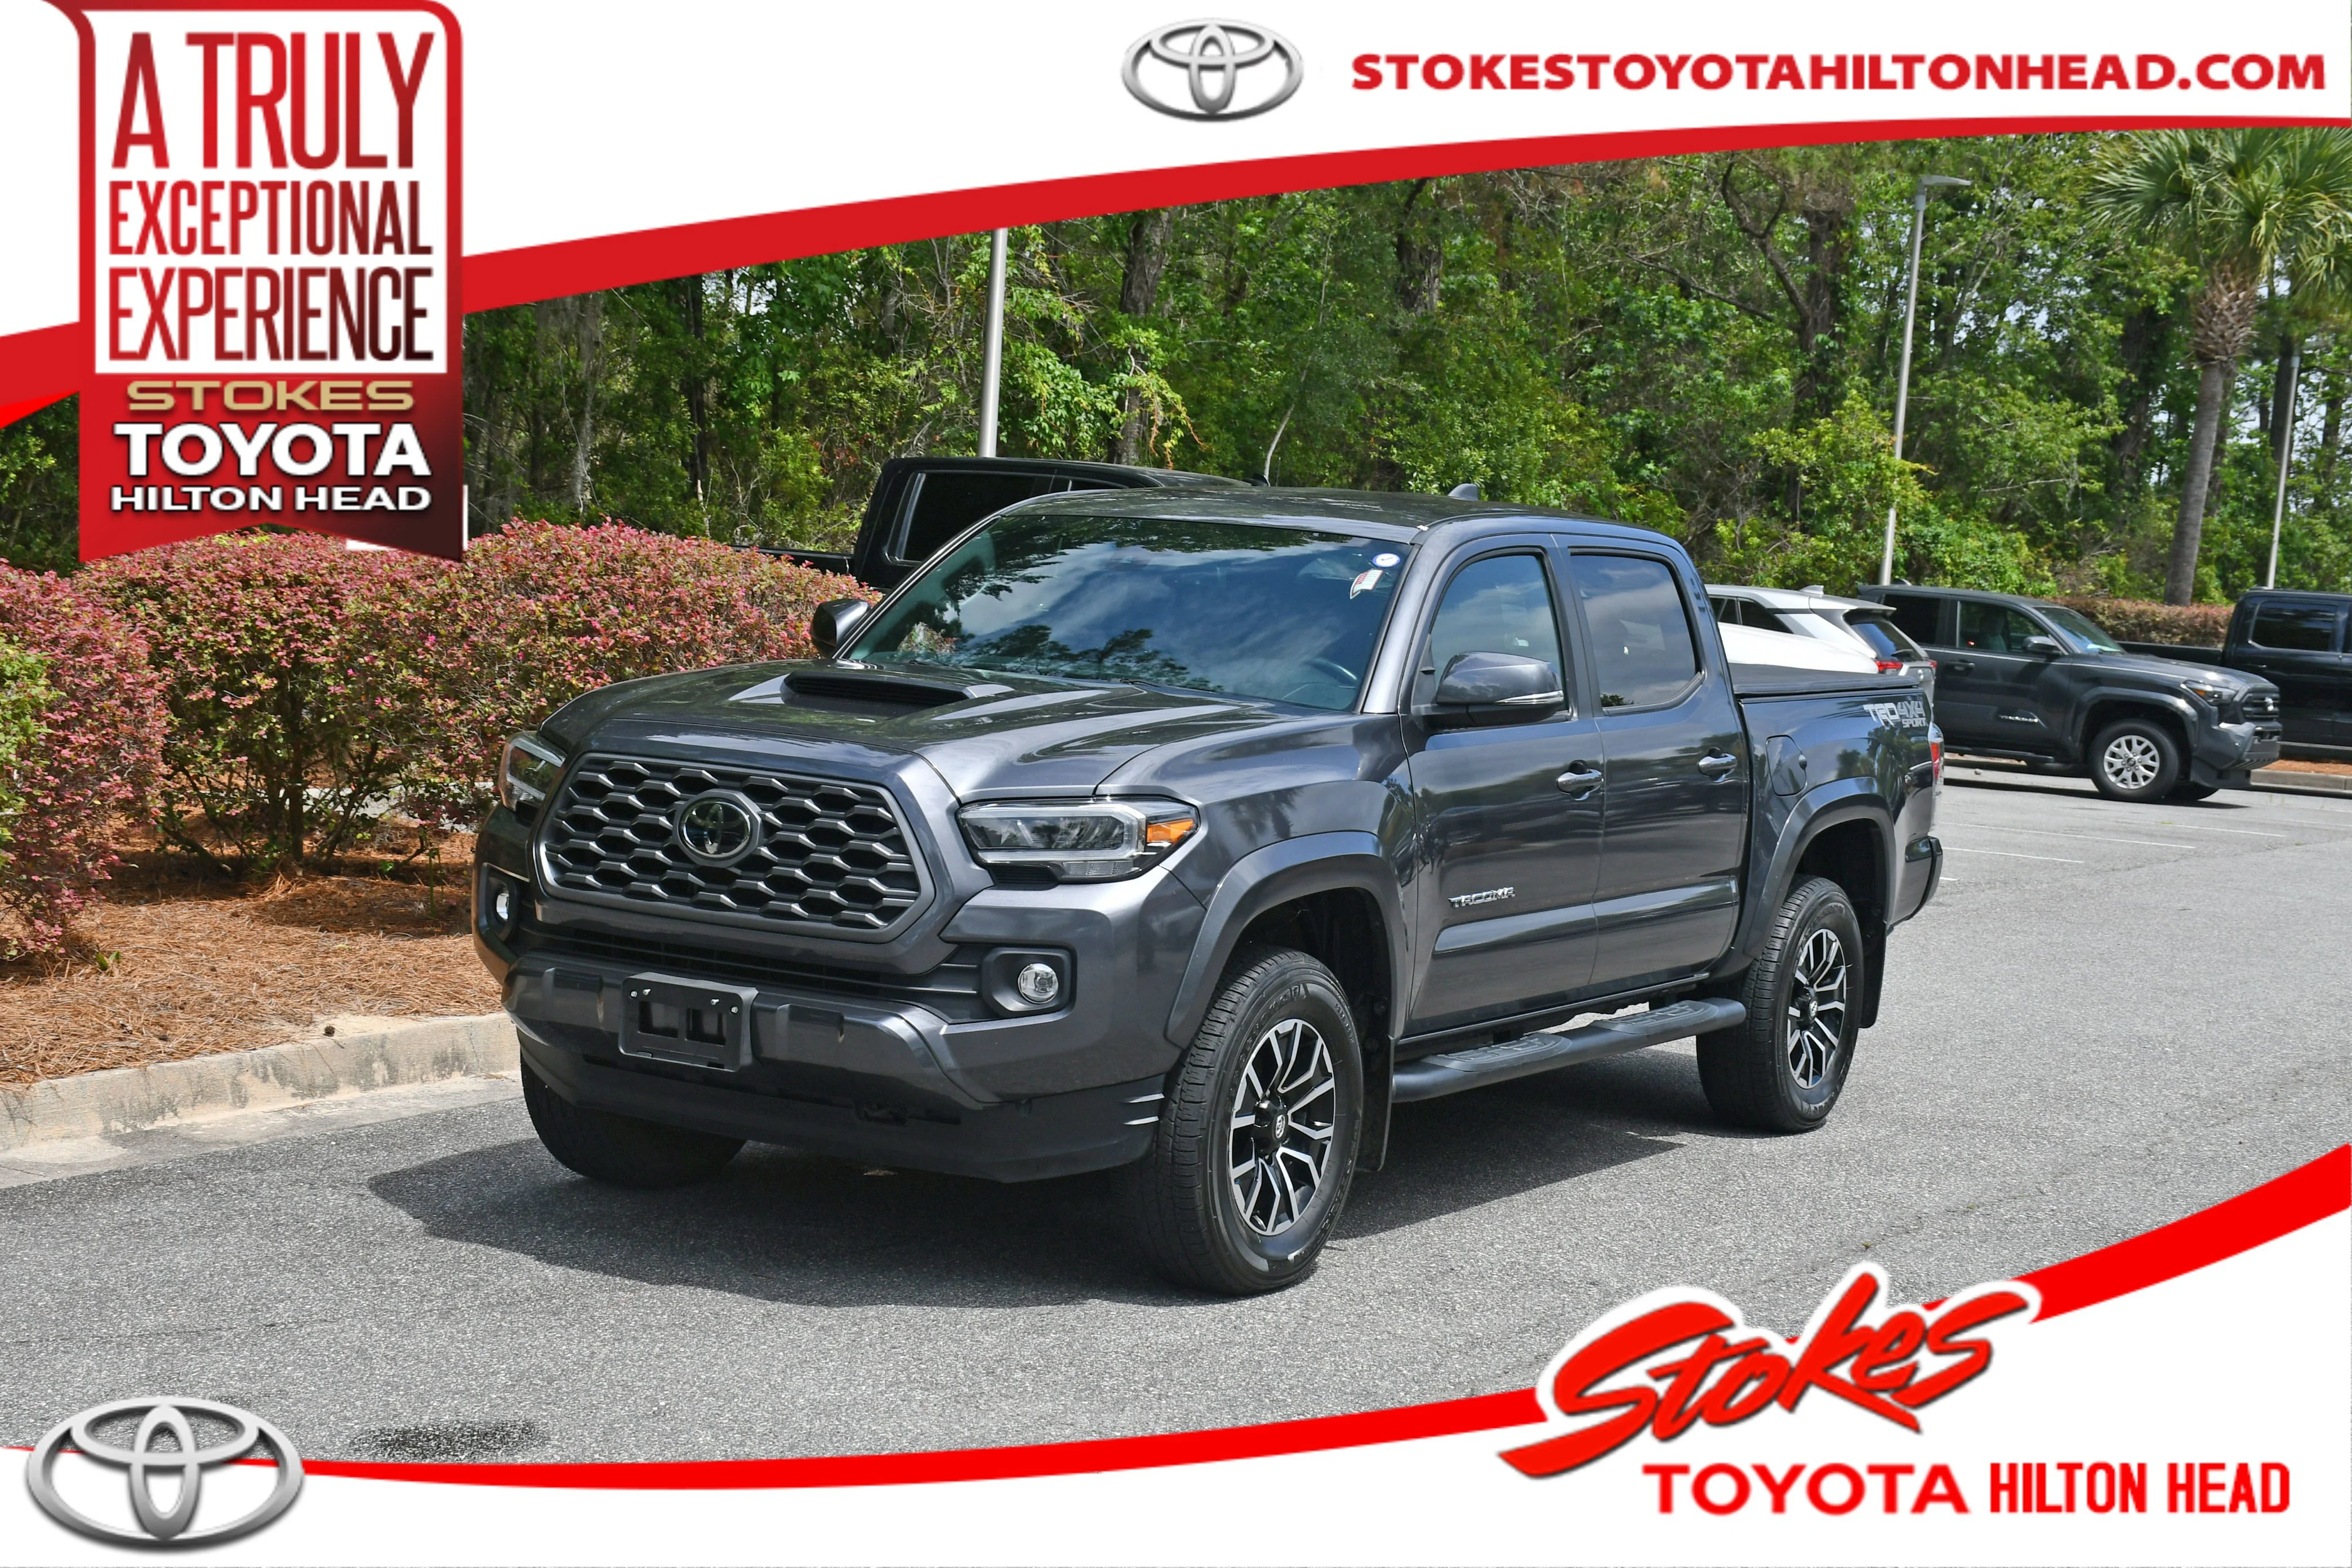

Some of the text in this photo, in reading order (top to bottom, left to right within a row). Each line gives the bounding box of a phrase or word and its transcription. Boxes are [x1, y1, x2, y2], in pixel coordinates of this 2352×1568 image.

[1863, 703, 1900, 726] TRD
[1901, 717, 1926, 728] SPORT
[1448, 887, 1515, 908] TACOMA
